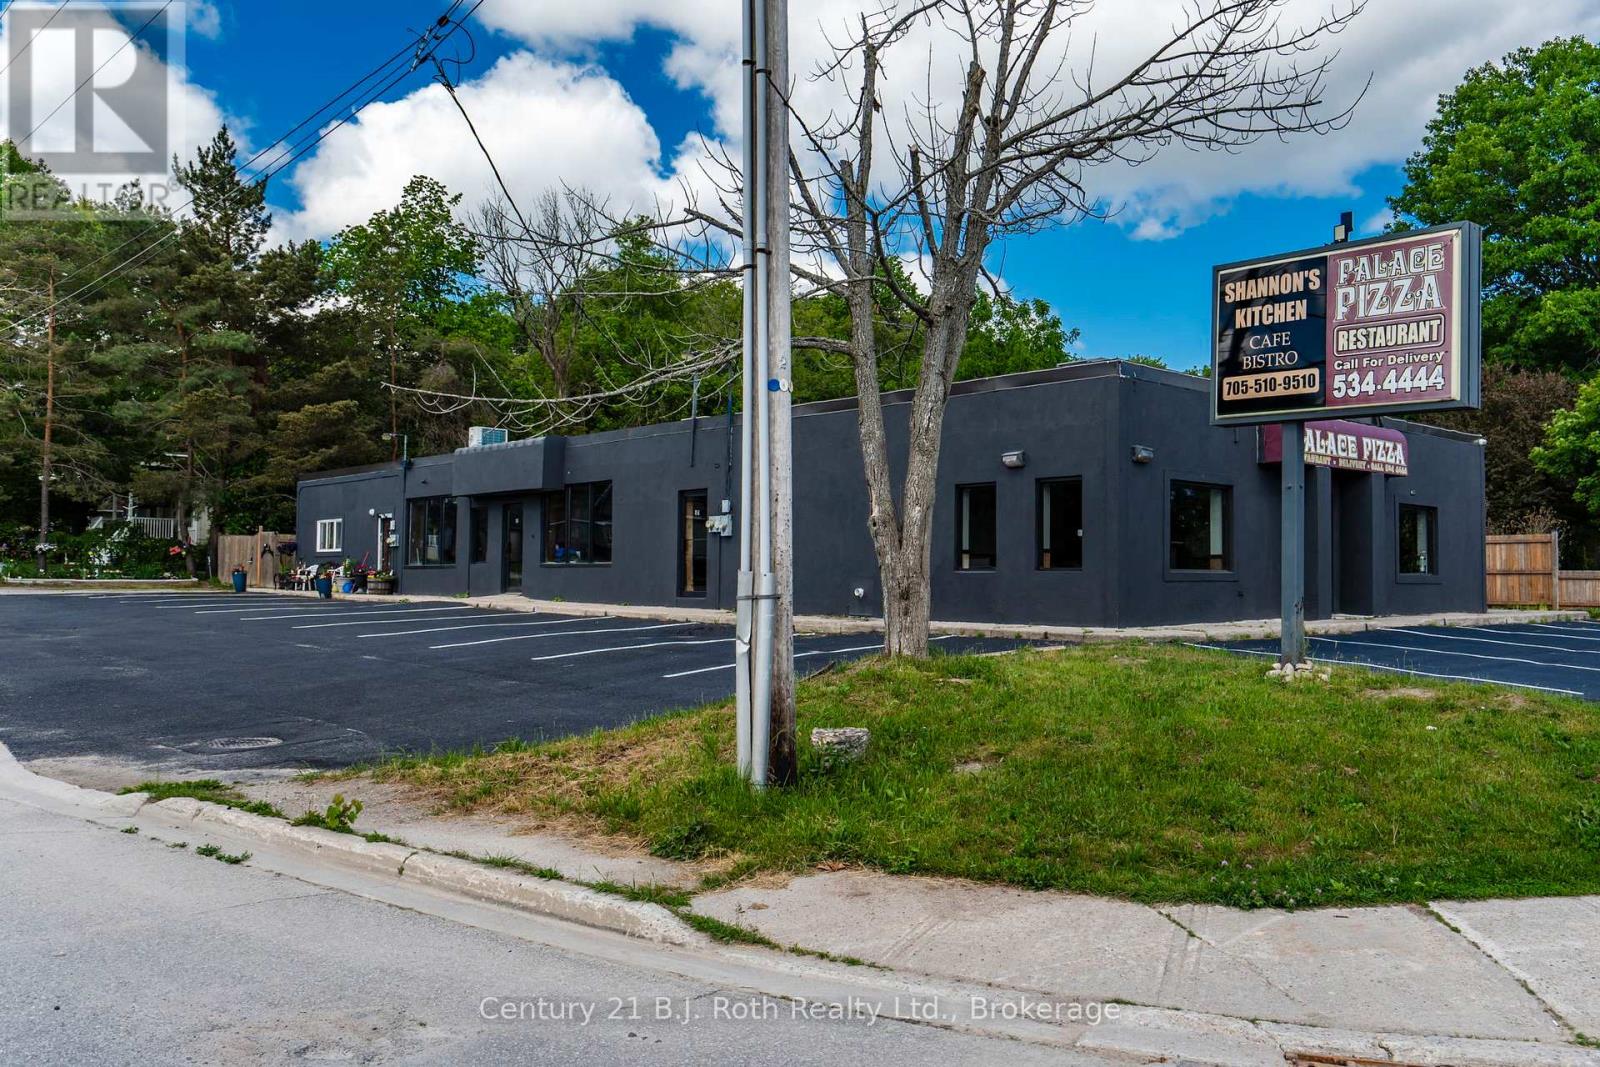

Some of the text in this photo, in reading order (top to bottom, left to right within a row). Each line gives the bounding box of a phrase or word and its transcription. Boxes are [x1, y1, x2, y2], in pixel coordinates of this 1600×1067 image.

[1338, 243, 1445, 284] PALACE
[1224, 268, 1321, 304] SHANNON'S
[1334, 274, 1446, 322] PIZZA
[1235, 299, 1307, 329] KITCHEN
[1249, 331, 1291, 350] CAFE
[1337, 319, 1441, 352] RESTAURANT
[1242, 350, 1298, 370] BISTRO
[1334, 351, 1445, 371] Call For Delivery
[1225, 372, 1317, 396] 705-510-9510
[1304, 428, 1407, 466] ALACE PIZZA
